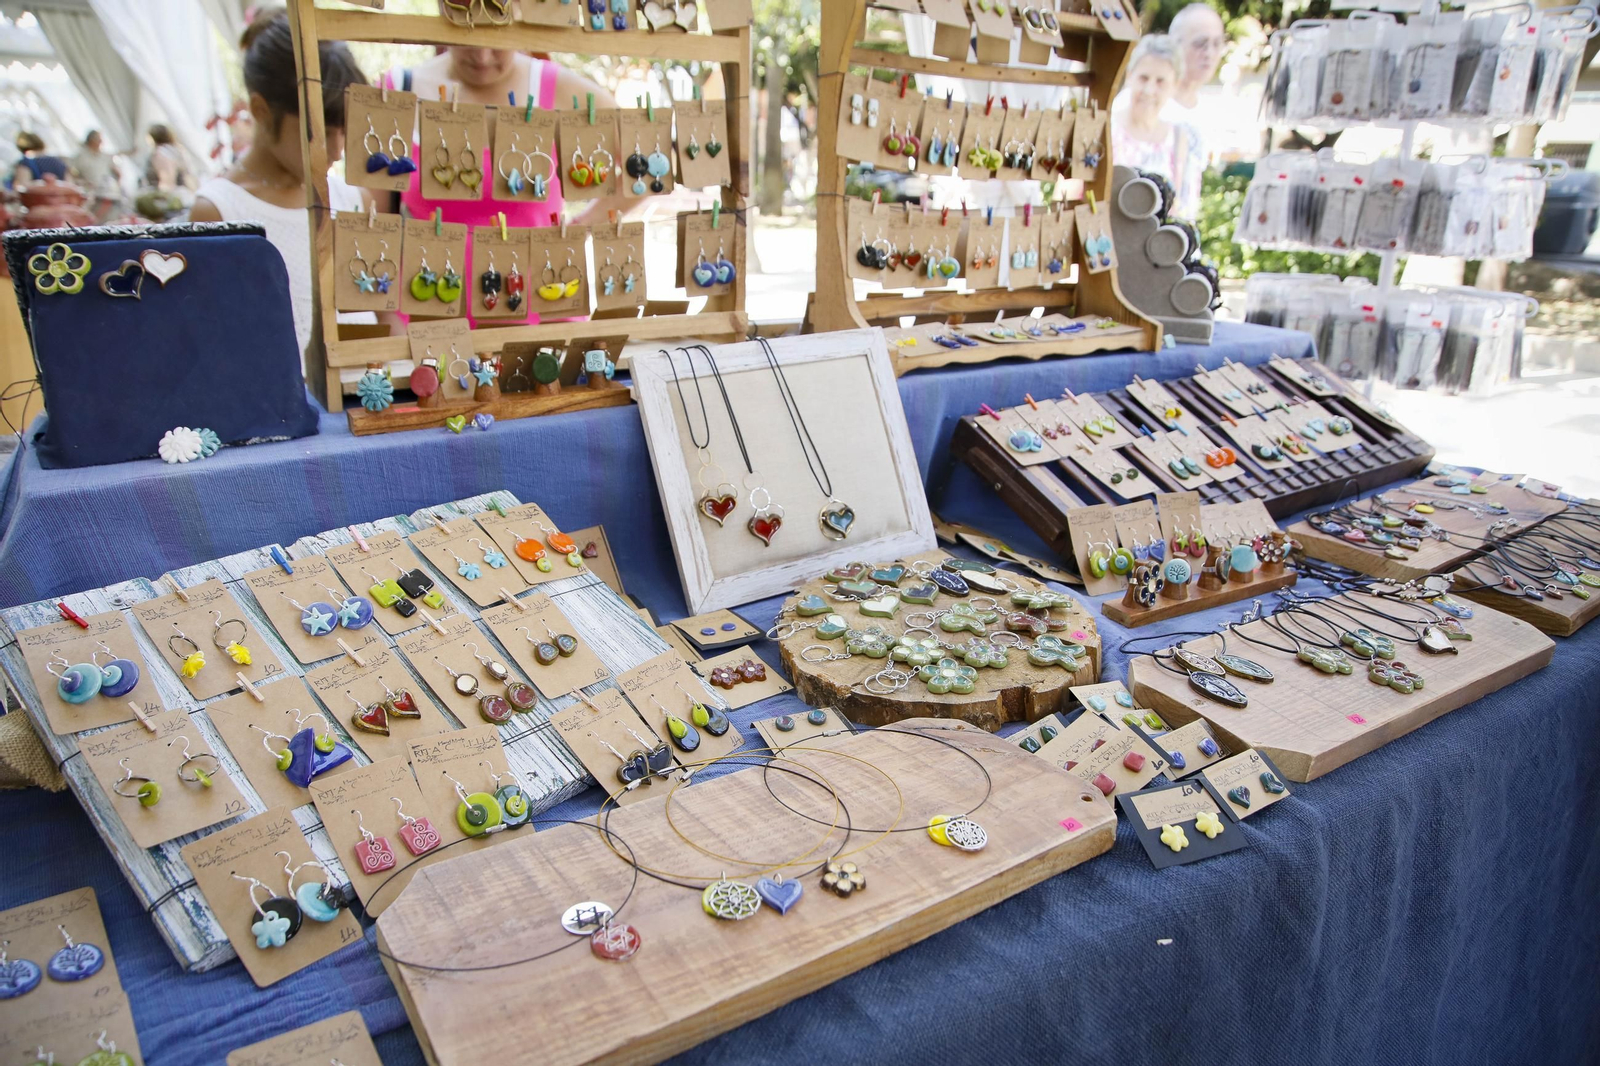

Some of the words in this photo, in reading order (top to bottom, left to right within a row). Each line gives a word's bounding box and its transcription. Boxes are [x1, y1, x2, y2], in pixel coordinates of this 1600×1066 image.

[264, 663, 283, 677] 12
[143, 702, 160, 715] 14
[413, 745, 442, 759] RITA
[1151, 759, 1164, 771] 10
[1182, 785, 1194, 797] 10
[224, 800, 245, 816] 12
[340, 926, 357, 943] 14
